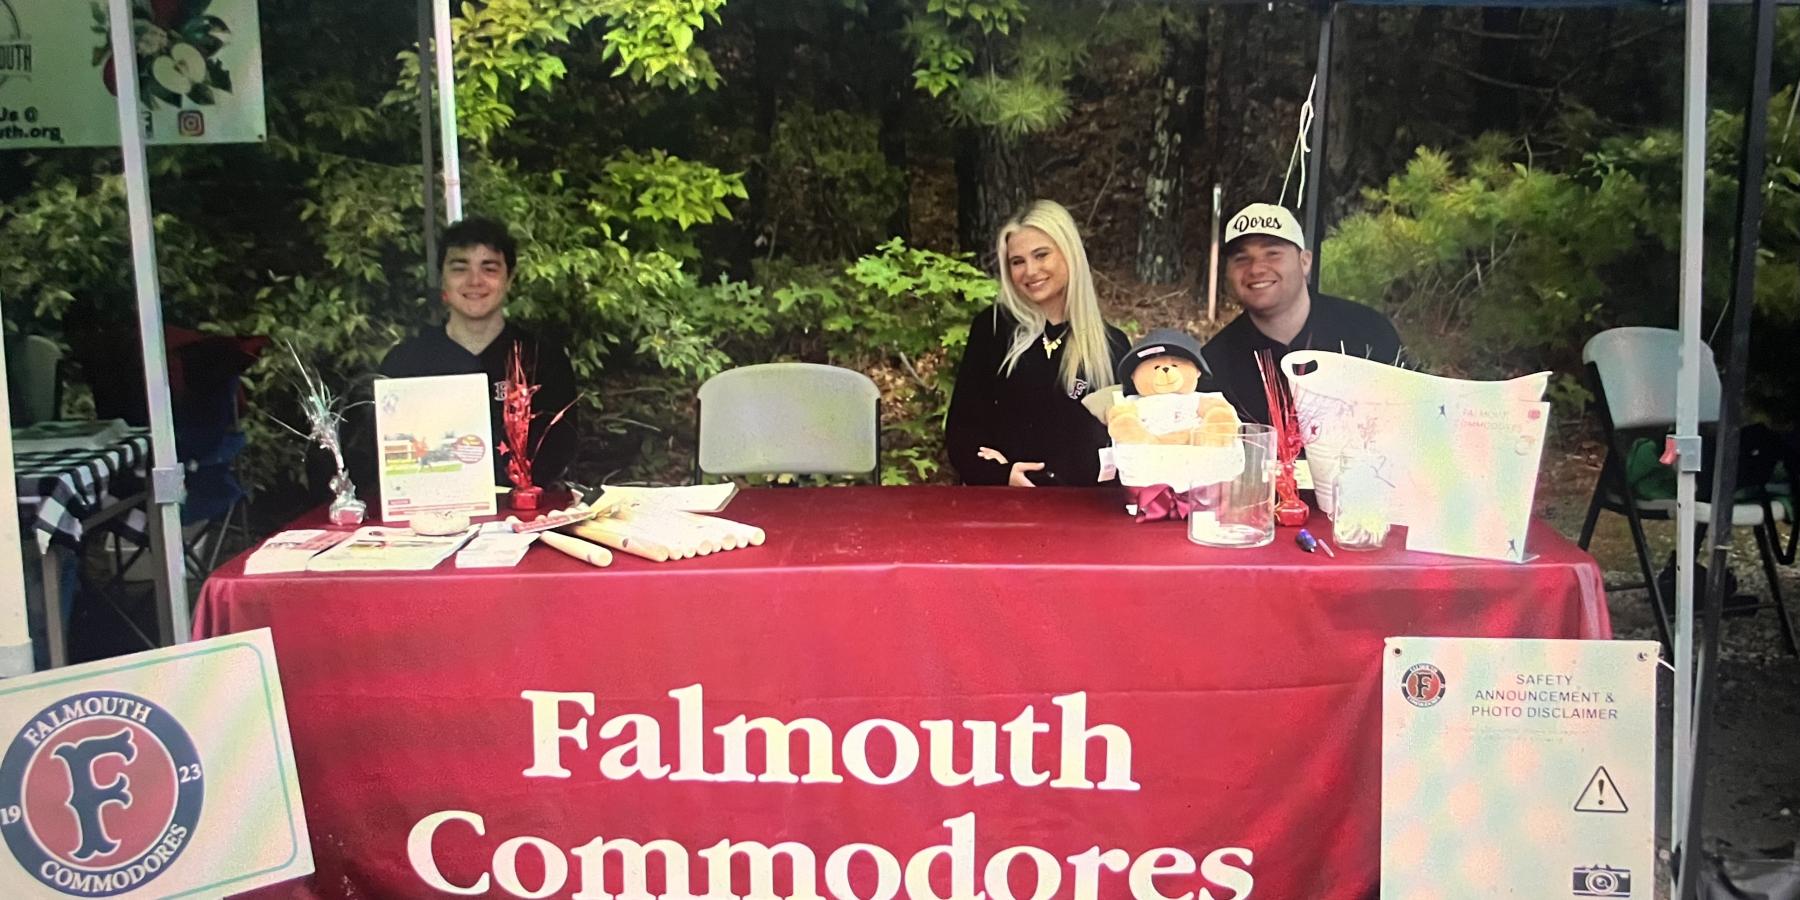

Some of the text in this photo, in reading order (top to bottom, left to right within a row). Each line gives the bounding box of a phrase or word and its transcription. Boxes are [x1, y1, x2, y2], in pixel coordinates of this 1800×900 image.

[1233, 215, 1282, 232] Dores
[1516, 673, 1574, 686] SAFETY
[1475, 689, 1616, 704] ANNOUNCEMENT &
[23, 696, 152, 748] FALMOUTH
[1471, 705, 1619, 720] PHOTO DISCLAIMER
[521, 683, 1141, 791] Falmouth
[179, 764, 202, 783] 23
[51, 726, 138, 863] F
[0, 804, 22, 825] 19
[40, 823, 188, 893] COMMODORES
[407, 811, 1254, 900] Commodores
